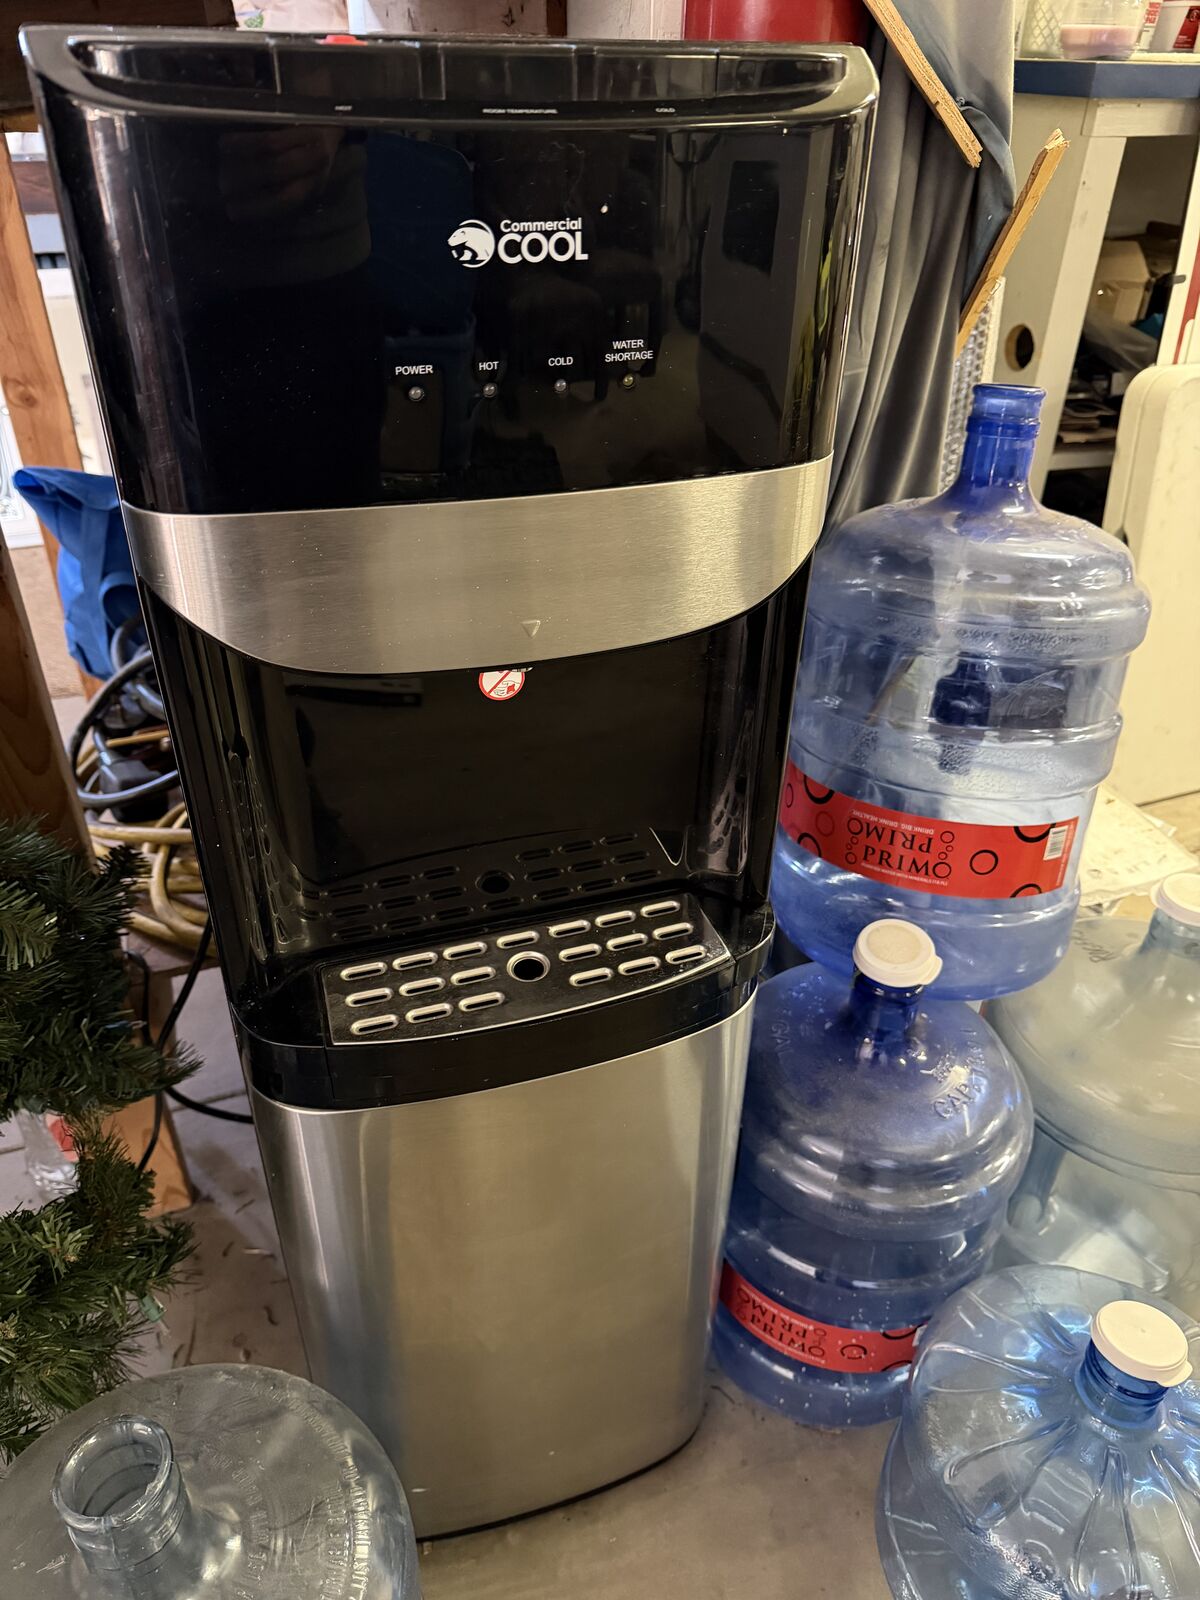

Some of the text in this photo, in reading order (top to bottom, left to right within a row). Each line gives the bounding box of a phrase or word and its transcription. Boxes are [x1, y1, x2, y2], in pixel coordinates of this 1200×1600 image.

[500, 217, 582, 233] Commercial
[498, 231, 589, 264] COOL
[612, 339, 644, 350] WATER
[548, 356, 574, 367] COLD
[604, 350, 654, 363] SHORTAGE
[395, 364, 434, 376] POWER
[478, 361, 499, 371] HOT
[847, 817, 933, 853] PRIMO
[863, 845, 952, 878] PRIMO
[737, 1287, 808, 1339] PRIMO
[750, 1313, 826, 1359] PRIMO
